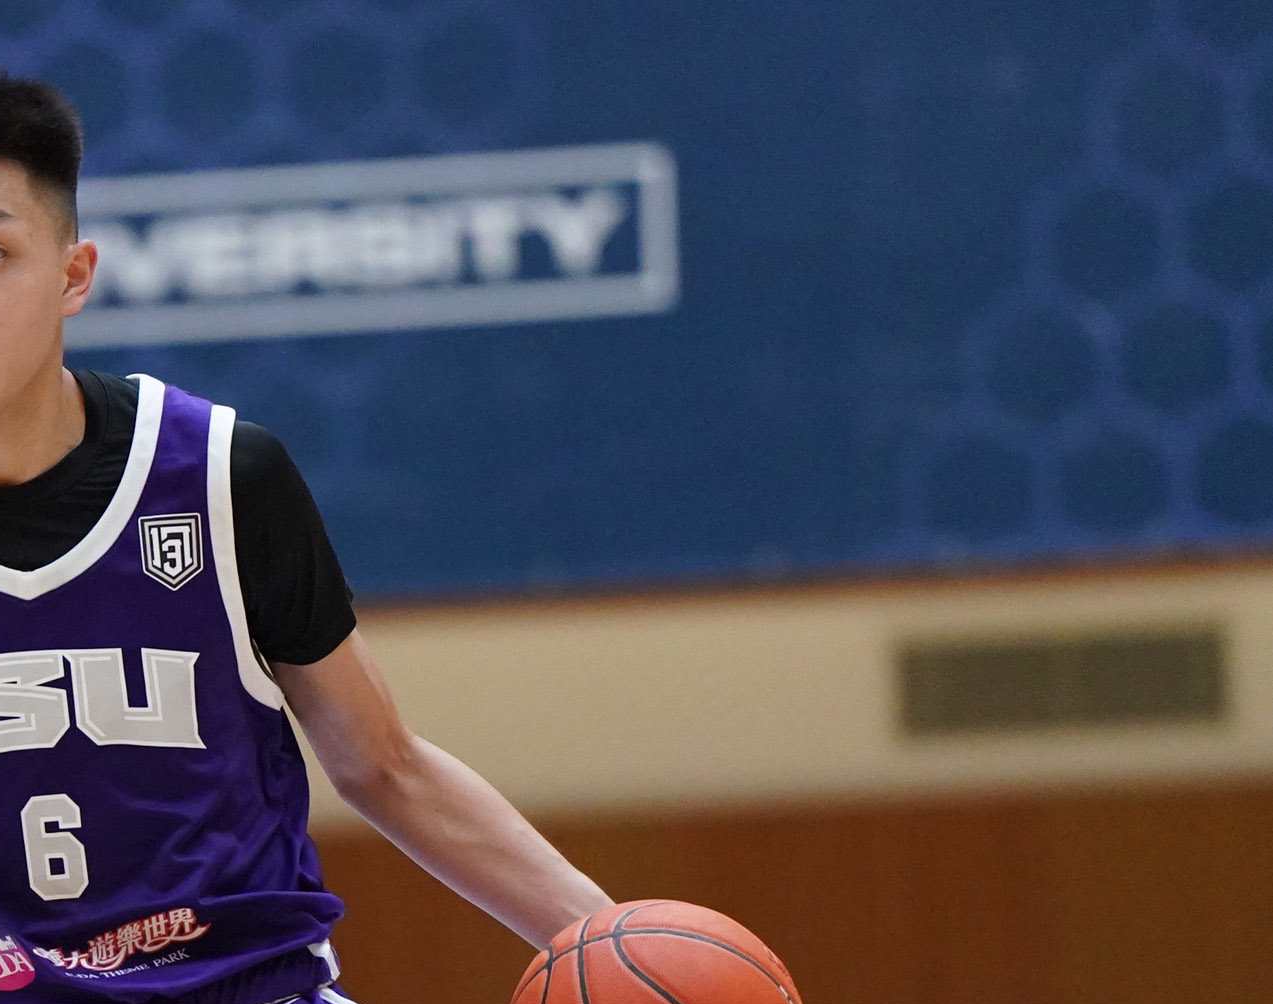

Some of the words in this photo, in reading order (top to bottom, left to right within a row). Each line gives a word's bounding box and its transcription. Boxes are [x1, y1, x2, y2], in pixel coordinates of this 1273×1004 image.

[76, 182, 630, 302] VERSITY
[20, 793, 89, 901] 6
[99, 964, 151, 978] THEME
[153, 948, 191, 968] PARK
